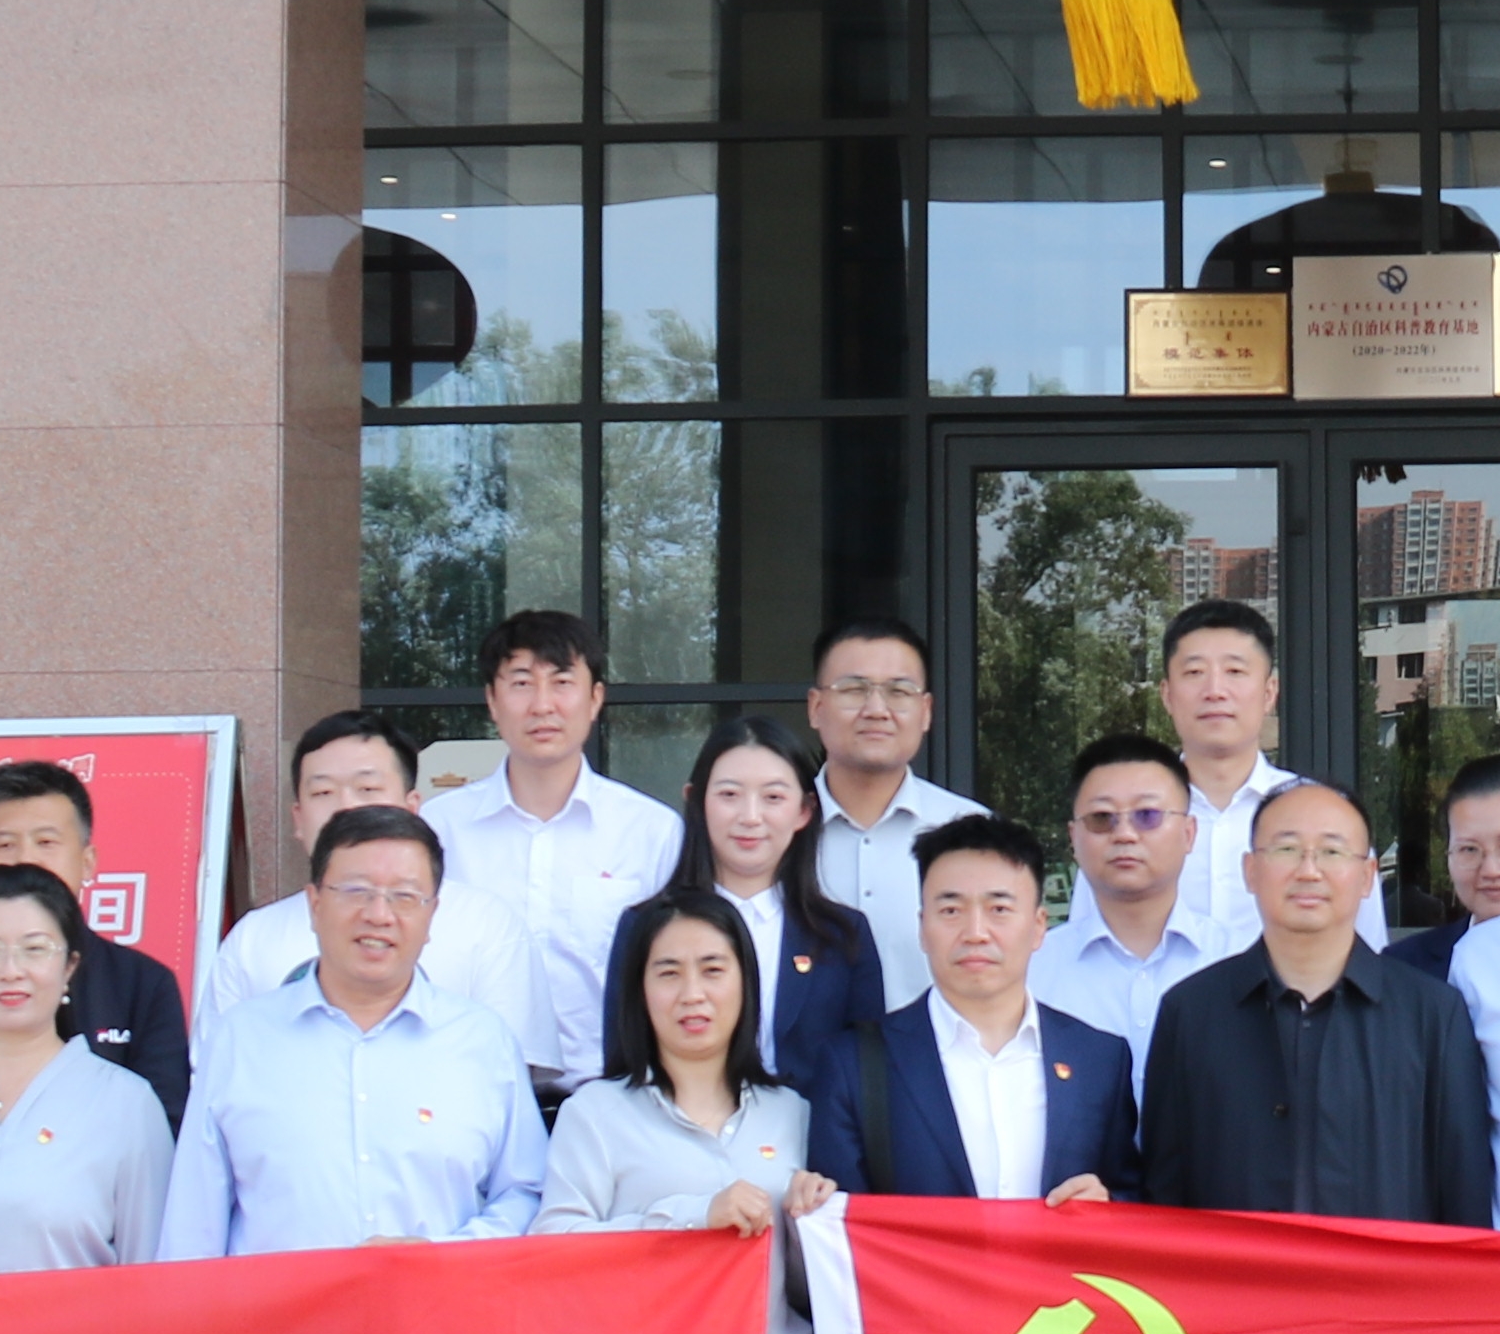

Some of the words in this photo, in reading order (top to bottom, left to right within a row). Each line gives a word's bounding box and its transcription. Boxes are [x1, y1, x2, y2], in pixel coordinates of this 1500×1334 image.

[1307, 320, 1479, 338] 内蒙古自治区科普教育基地
